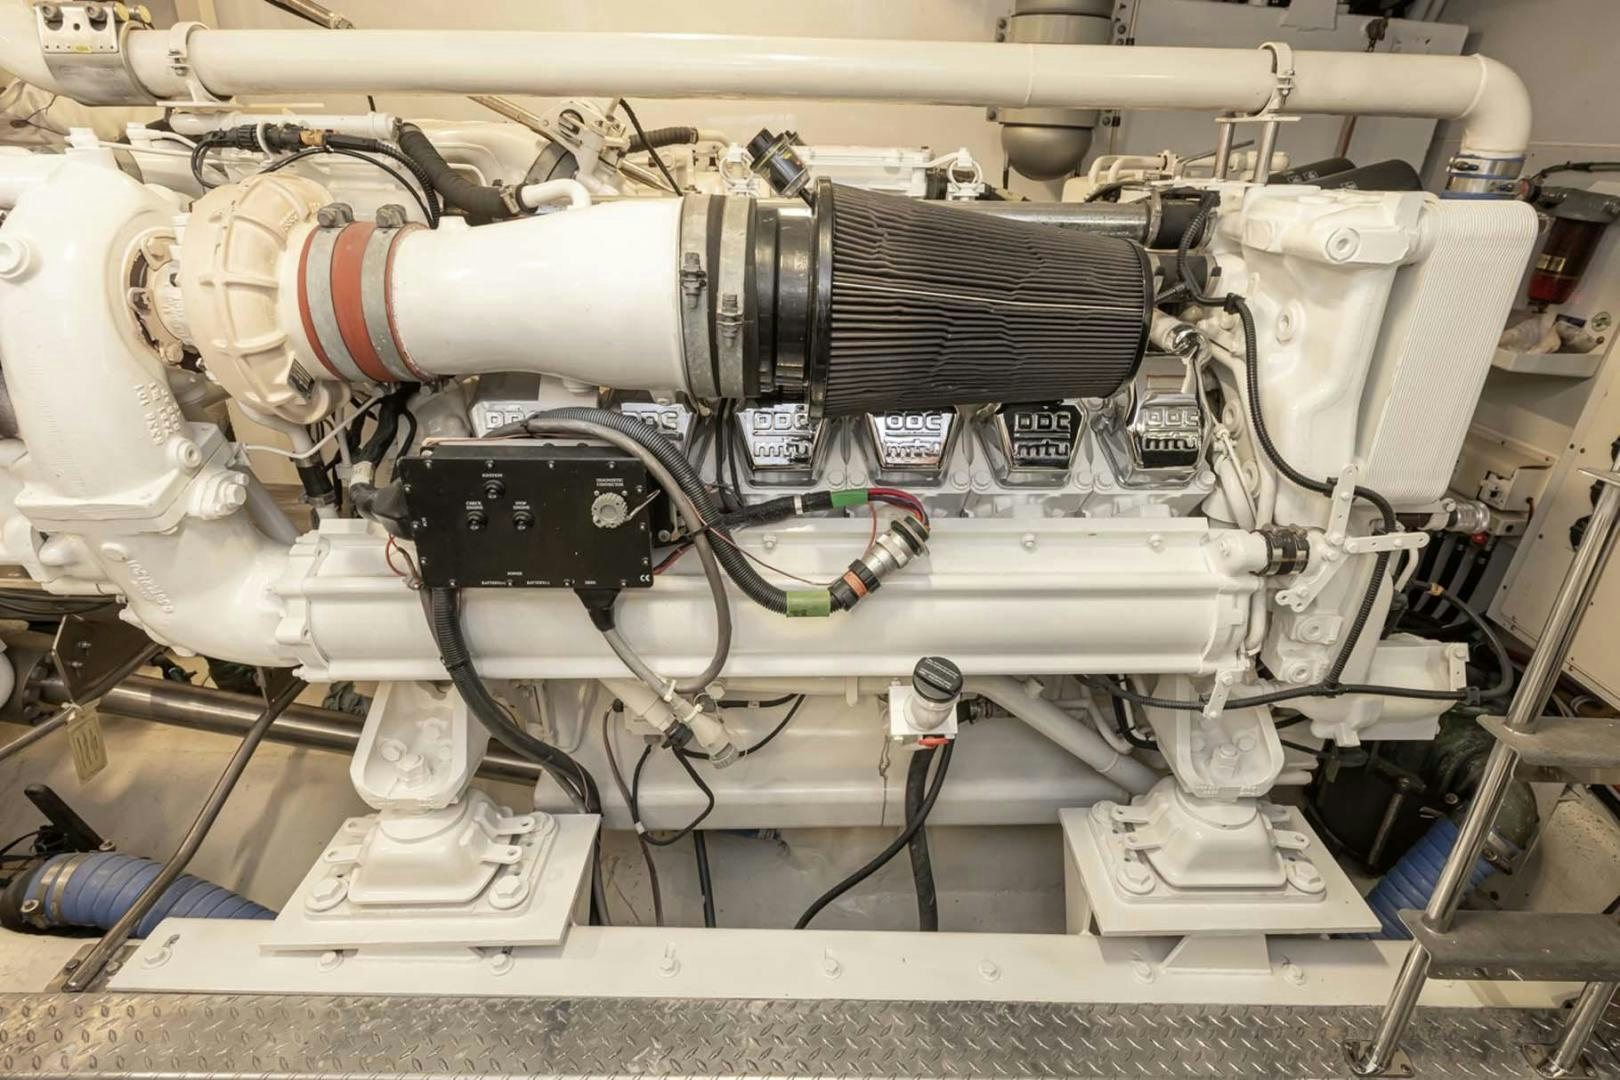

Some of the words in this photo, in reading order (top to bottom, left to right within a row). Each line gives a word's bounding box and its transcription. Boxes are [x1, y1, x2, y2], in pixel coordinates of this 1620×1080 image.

[486, 410, 526, 430] DD
[753, 411, 809, 430] DDC
[884, 410, 942, 430] DDC
[1014, 411, 1071, 431] DDC
[1143, 408, 1199, 428] DDC
[884, 438, 942, 458] mtu
[1013, 438, 1071, 460] mtu
[1142, 431, 1199, 451] mtu
